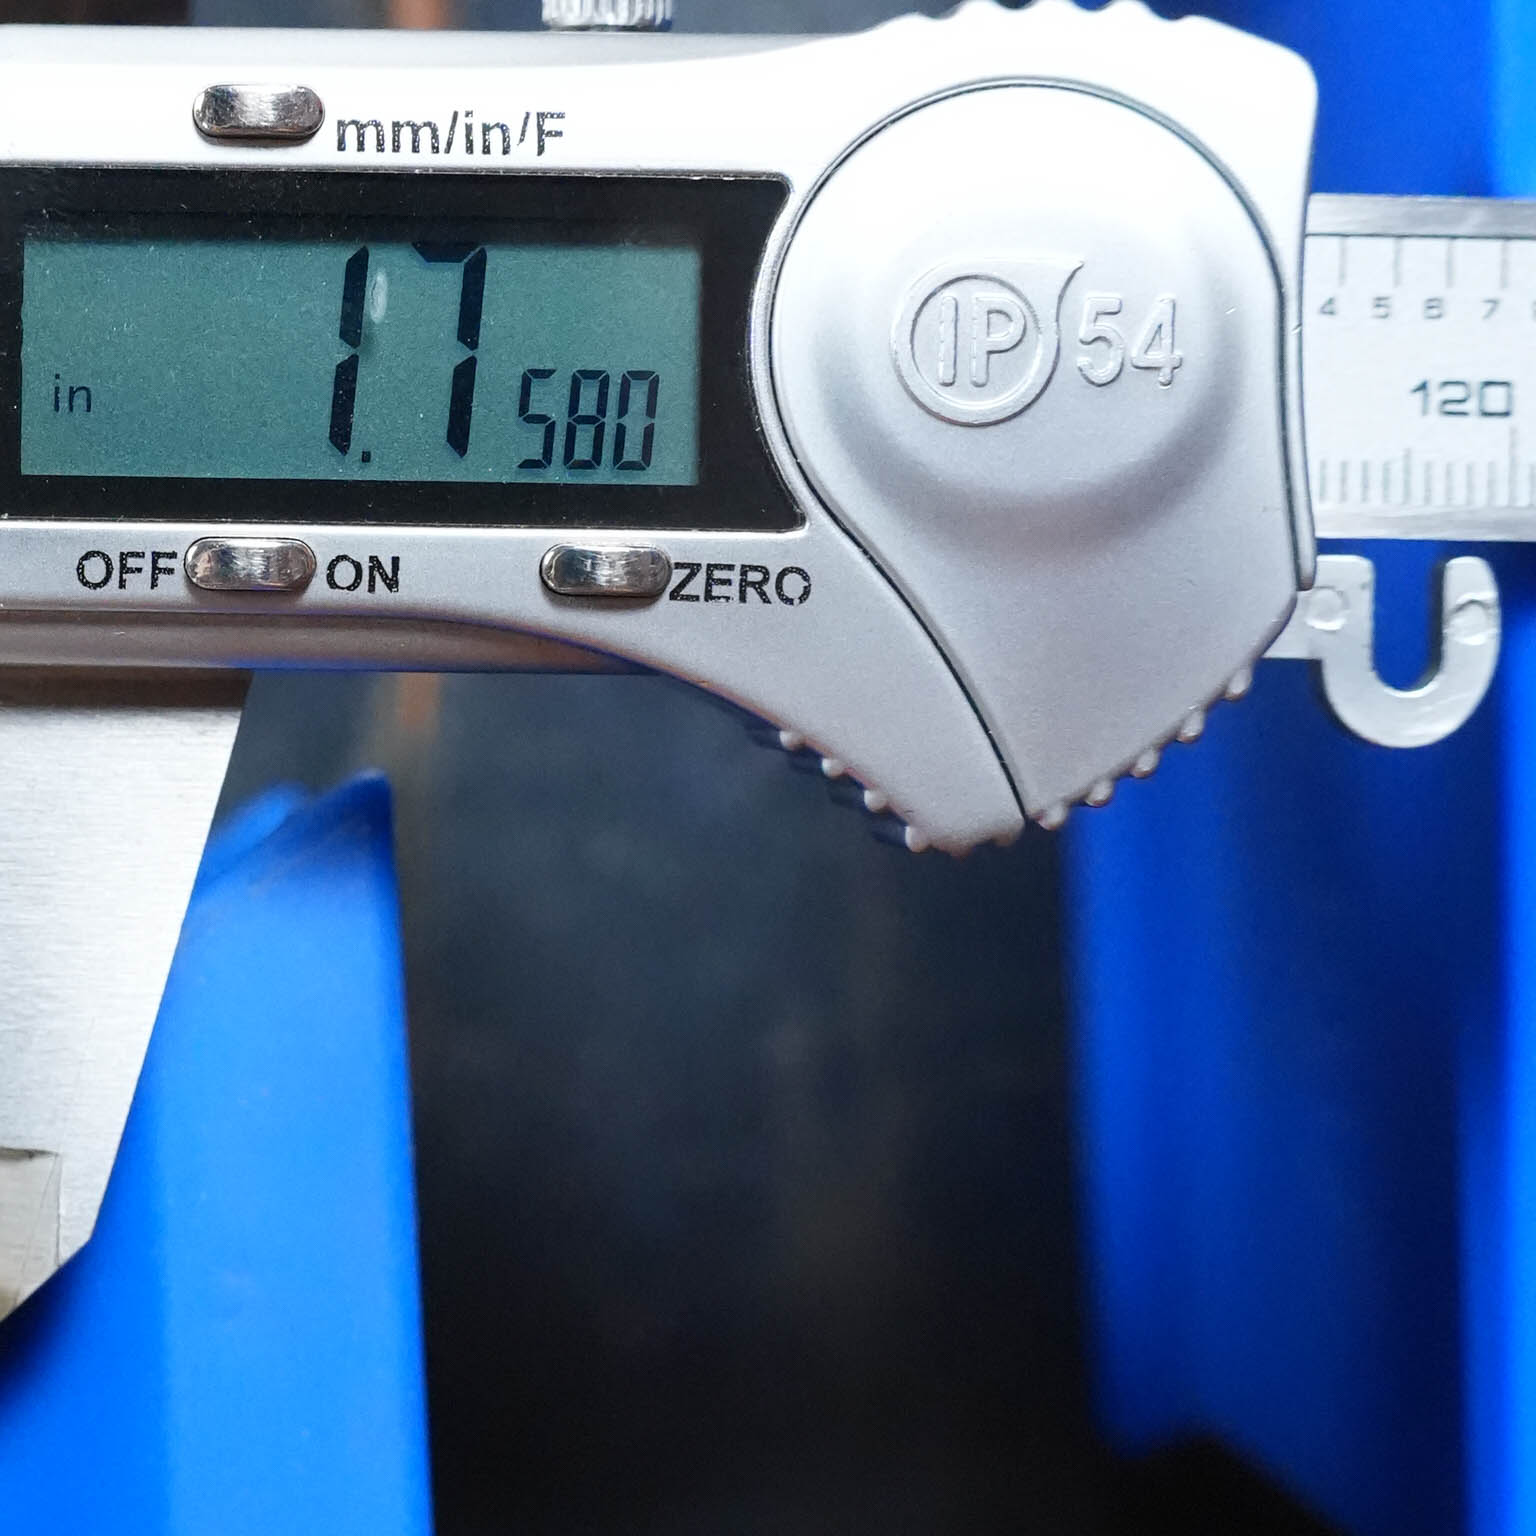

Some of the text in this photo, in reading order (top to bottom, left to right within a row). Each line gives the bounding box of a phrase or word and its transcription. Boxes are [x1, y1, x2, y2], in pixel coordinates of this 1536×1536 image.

[335, 109, 566, 158] mm/in/F
[1318, 296, 1500, 320] 4 5 6 7
[52, 373, 92, 414] in
[1410, 379, 1514, 418] 120
[74, 549, 177, 592] OFF
[325, 553, 401, 595] ON
[668, 560, 812, 607] ZERO
